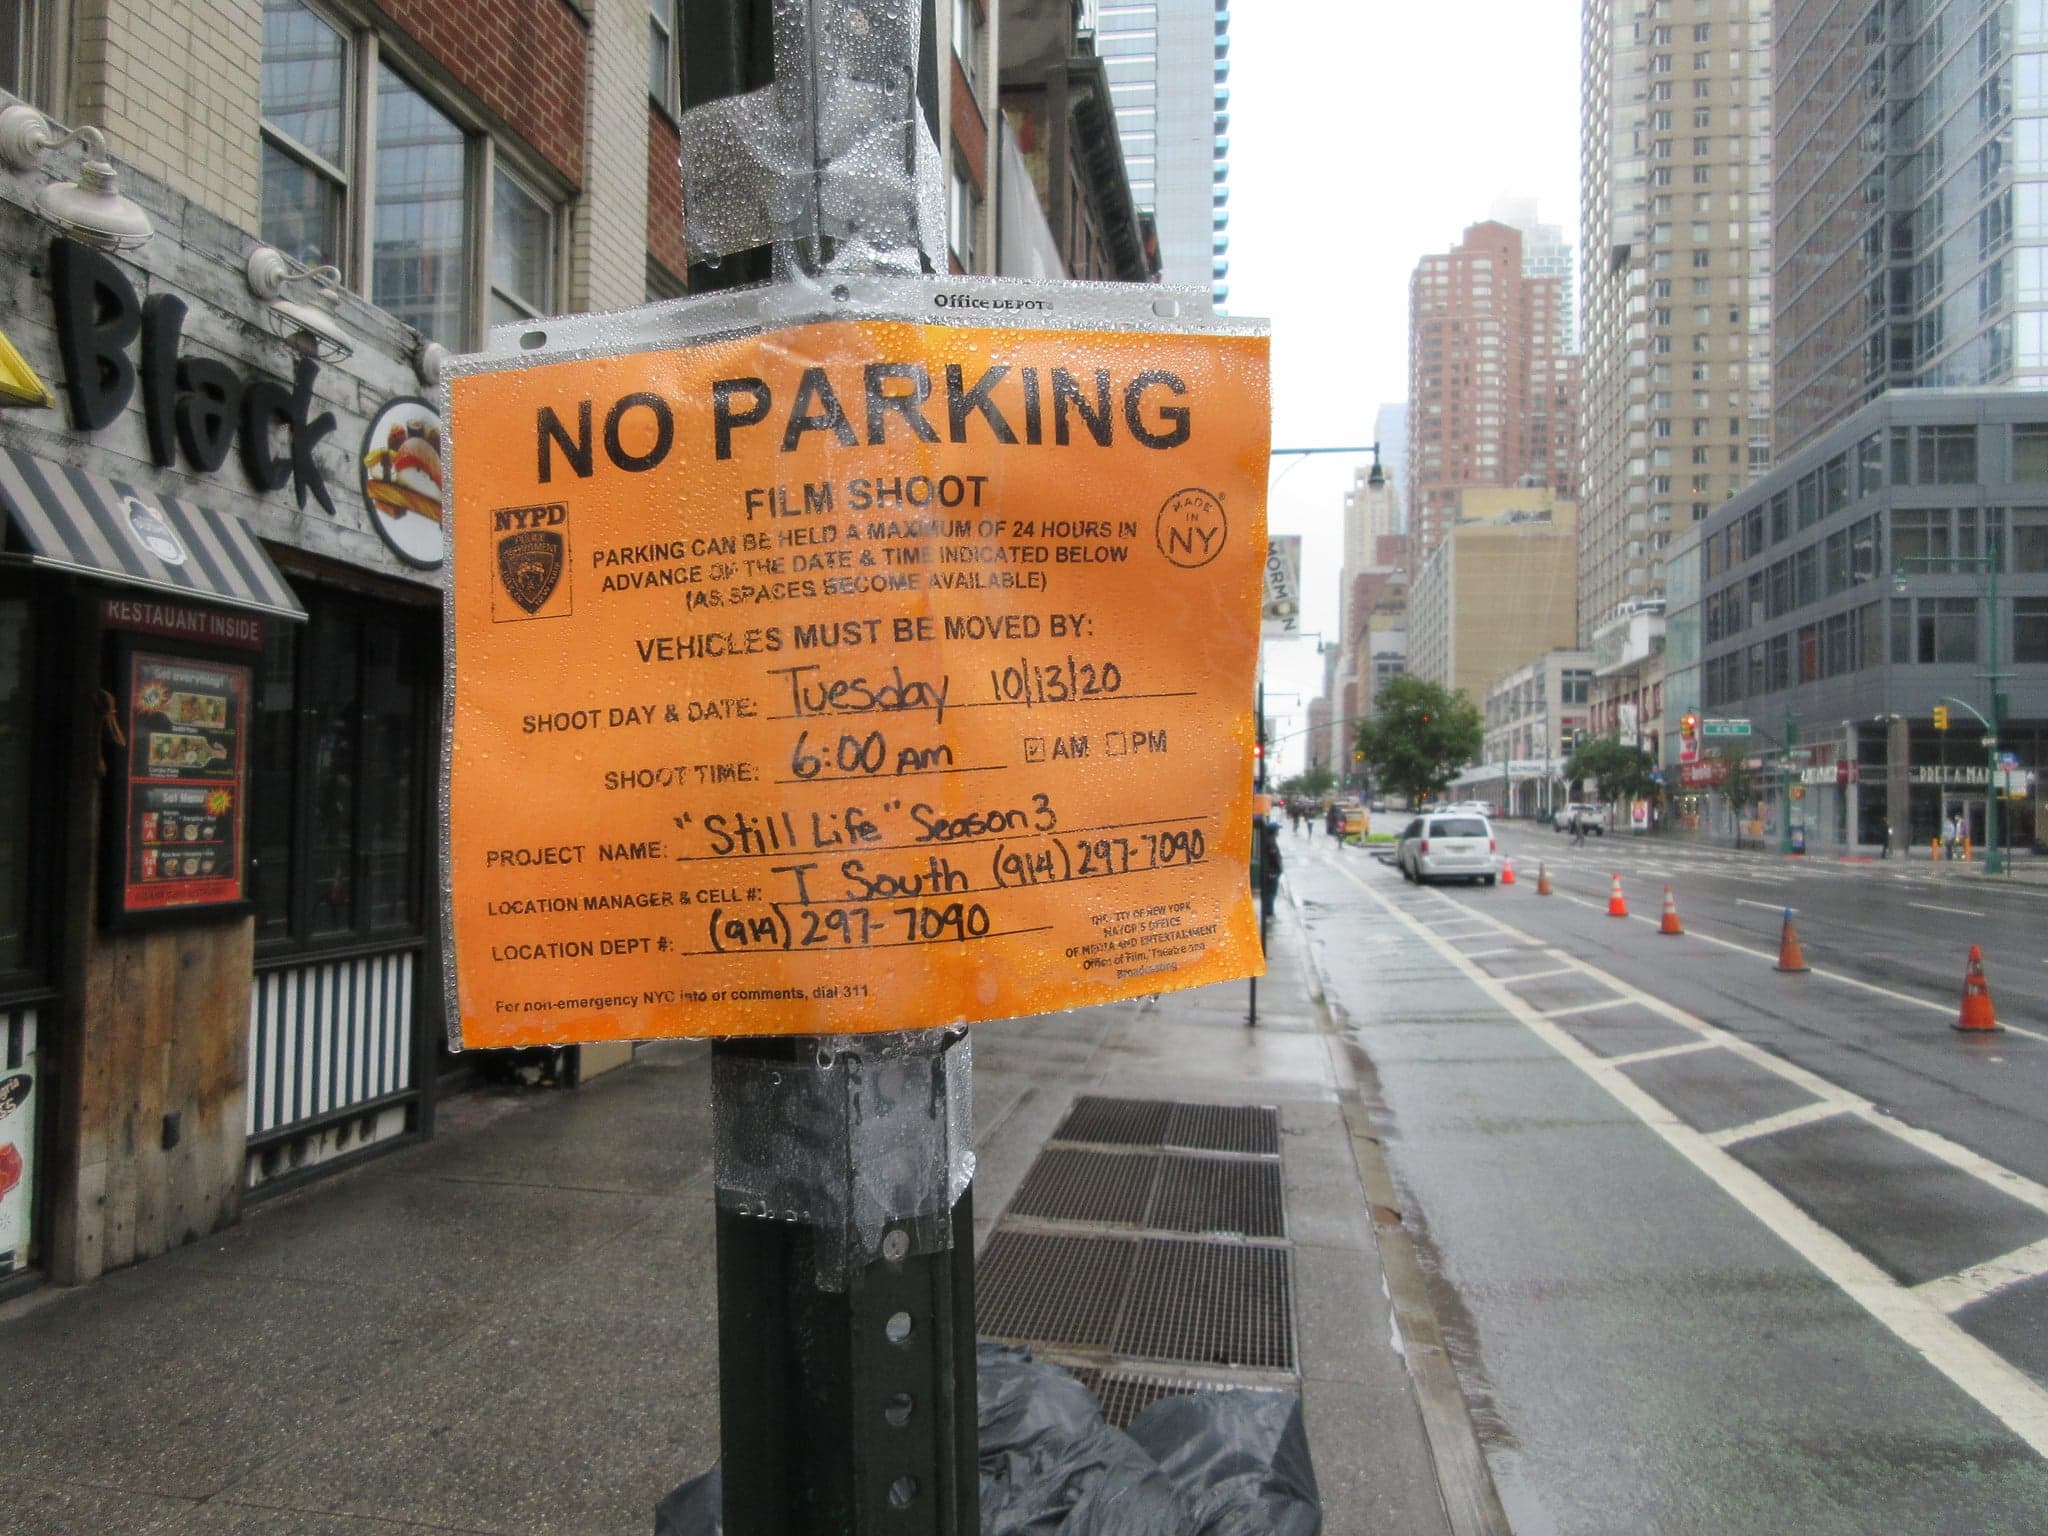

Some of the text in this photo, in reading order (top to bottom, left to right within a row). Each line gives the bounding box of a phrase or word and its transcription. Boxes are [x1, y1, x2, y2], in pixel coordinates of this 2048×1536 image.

[935, 294, 1047, 310] Office DEPOT
[51, 232, 338, 516] Black
[537, 362, 1190, 484] NO PARKING
[745, 475, 988, 520] FILM SHOOT
[1173, 497, 1213, 512] MADE
[494, 504, 566, 531] NYPD
[1185, 513, 1199, 521] IN
[593, 519, 1138, 568] PARKING CAN BE HELD A MAXIMUM OF 24 HOURS IN
[1169, 527, 1218, 554] NY
[601, 566, 701, 593] ADVANCE
[743, 556, 785, 577] THE
[792, 550, 853, 571] DATE
[859, 550, 876, 567] &
[885, 547, 937, 565] TIME
[940, 546, 1049, 564] INDICATED
[1055, 546, 1129, 563] BELOW
[728, 579, 817, 604] SPACES
[928, 571, 1048, 592] AVAILABLE)
[108, 600, 260, 641] RESTAUANT INSIDE
[636, 613, 1094, 662] VEHICLES MUST BE MOVED BY:
[766, 655, 1122, 725] Tuesday 10/13/20
[522, 697, 758, 734] SHOOT DAY & DATE:
[791, 730, 886, 779] 6:00
[1052, 729, 1168, 760] AM PM
[604, 762, 760, 790] SHOOT TIME:
[674, 810, 797, 855] "Still
[909, 802, 1028, 843] Season
[1032, 792, 1058, 832] 3
[486, 841, 669, 868] PROJECT NAME:
[771, 862, 818, 906] T
[841, 855, 969, 901] South
[488, 897, 578, 917] LOCATION
[583, 891, 673, 911] MANAGER
[679, 890, 692, 907] &
[696, 888, 743, 904] CELL
[1168, 902, 1191, 914] YORK
[491, 941, 594, 962] LOCATION
[600, 938, 652, 956] DEPT
[1065, 946, 1079, 958] OF
[1140, 924, 1218, 946] ENTERTAINMENT
[496, 1000, 519, 1013] For
[524, 993, 639, 1013] non-emergency
[643, 990, 676, 1005] NYC
[712, 990, 728, 1001] or
[730, 986, 808, 1002] comments,
[813, 985, 838, 999] dial
